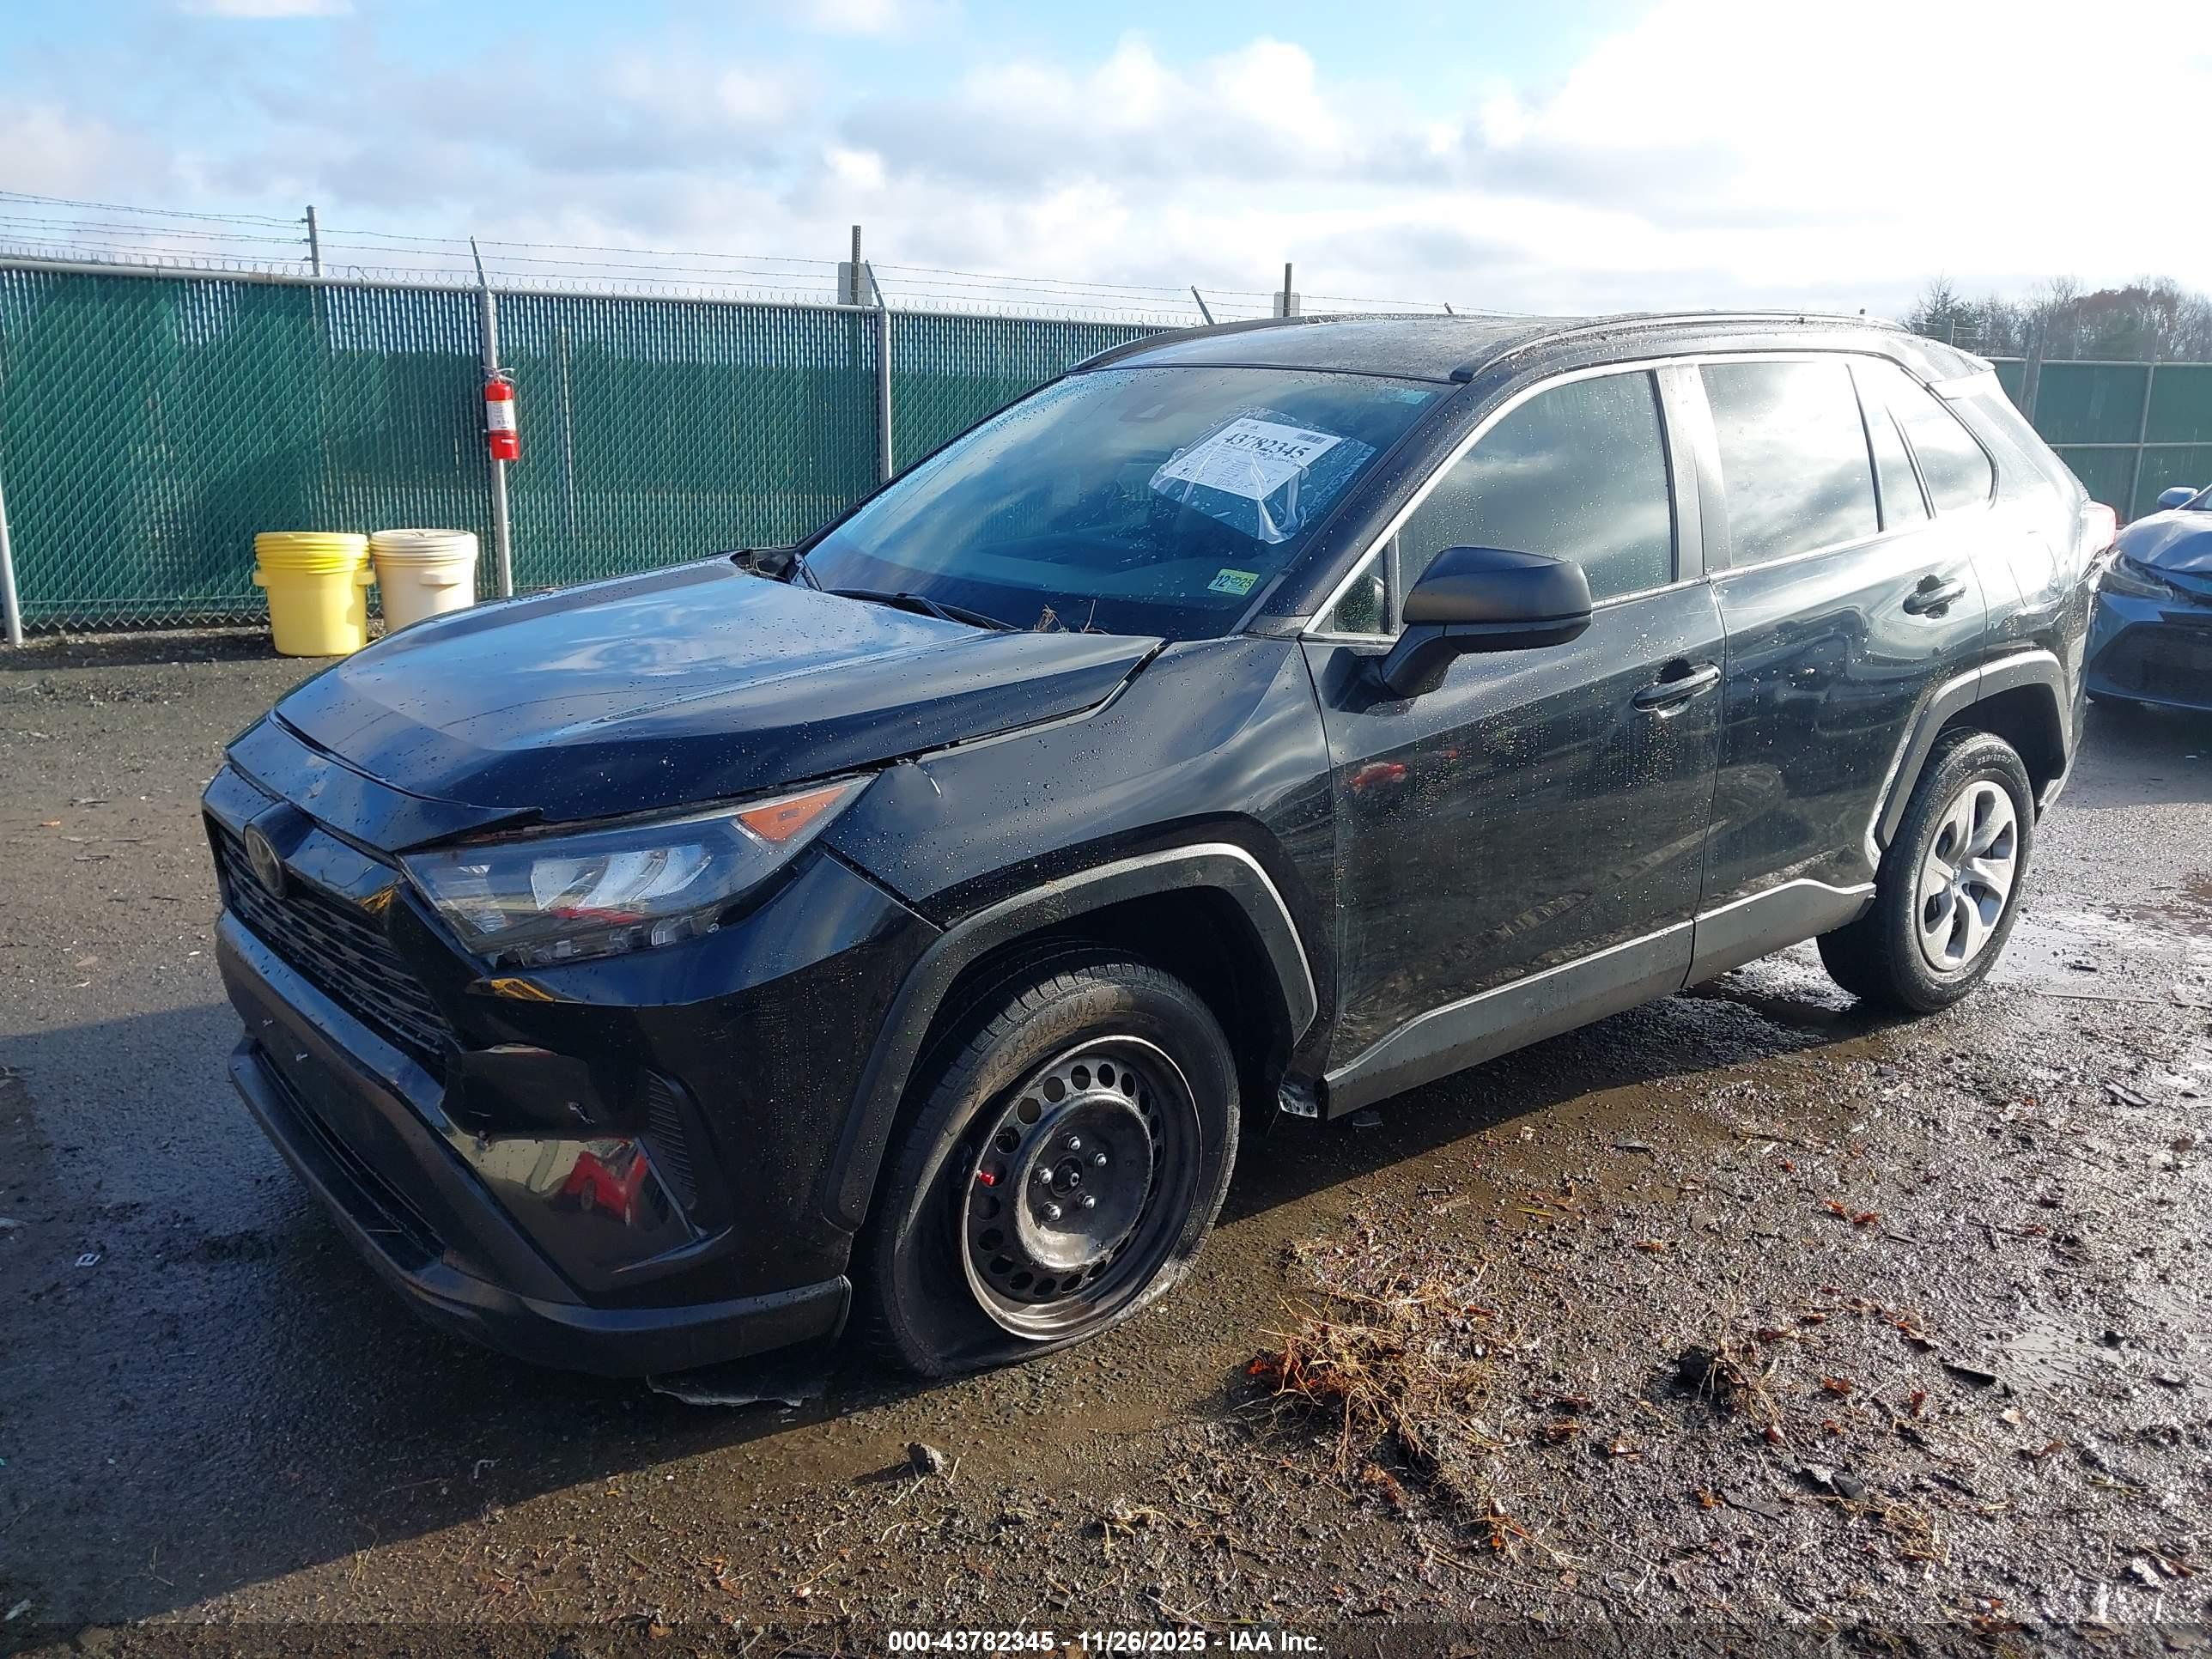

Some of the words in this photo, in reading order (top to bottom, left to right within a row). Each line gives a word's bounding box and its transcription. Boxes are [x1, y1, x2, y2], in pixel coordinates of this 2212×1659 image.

[1224, 432, 1310, 459] 43782345
[1213, 575, 1231, 587] 12
[1238, 577, 1255, 589] 25
[988, 996, 1097, 1072] OKOHAMA
